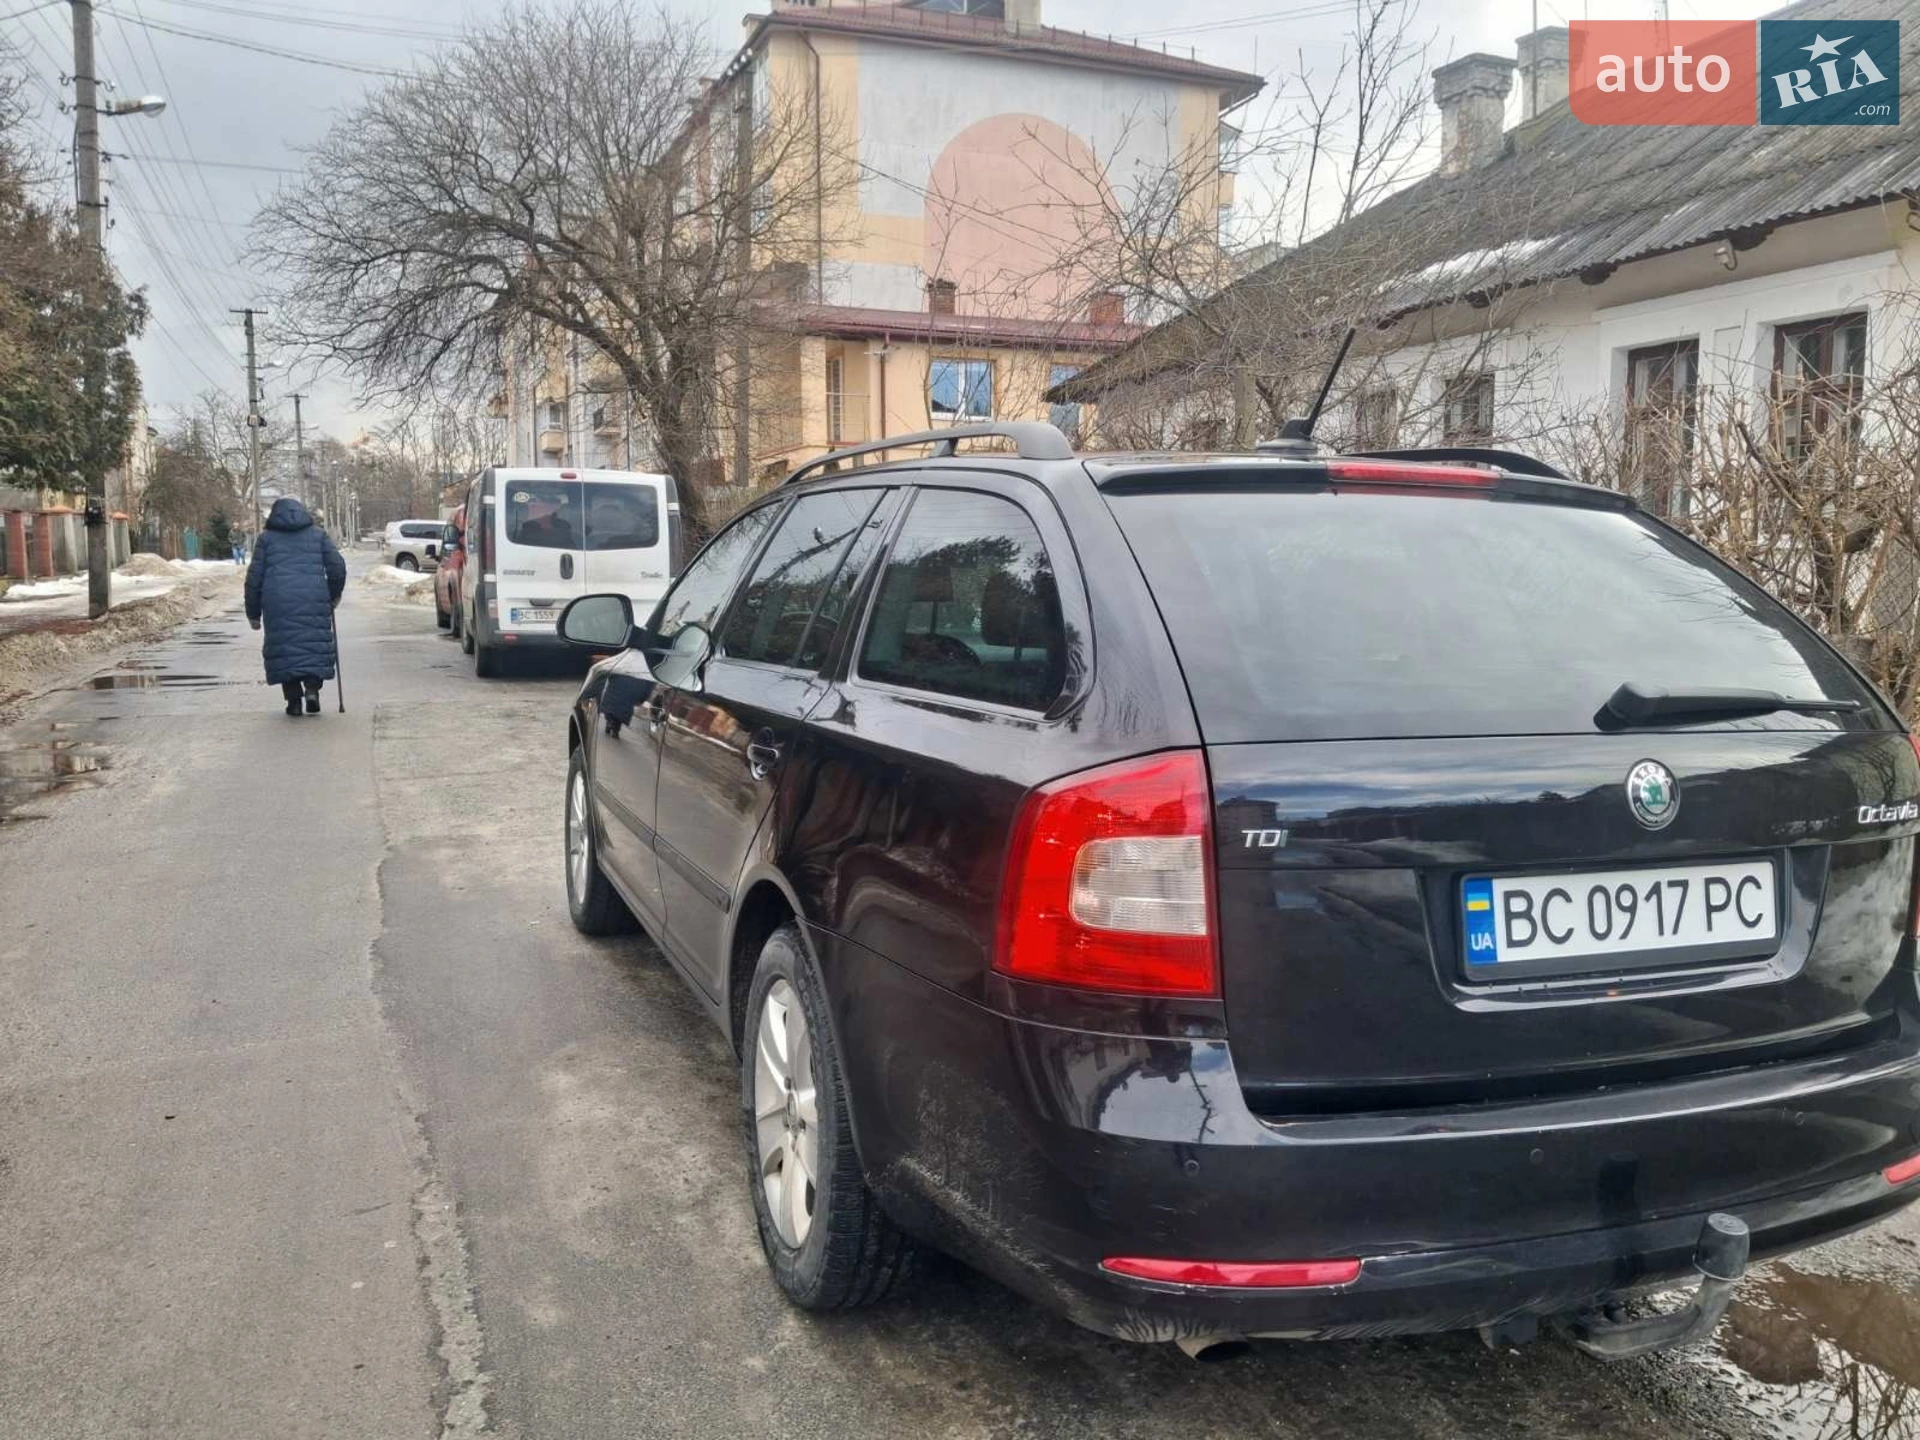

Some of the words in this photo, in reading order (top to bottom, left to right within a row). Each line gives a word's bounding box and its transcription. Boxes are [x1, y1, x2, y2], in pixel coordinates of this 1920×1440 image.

[1858, 801, 1919, 824] Octavia
[1241, 829, 1289, 848] TDI
[1502, 887, 1575, 949] BC
[1587, 879, 1690, 941] 0917
[1703, 874, 1764, 932] PC
[1471, 932, 1494, 951] UA
